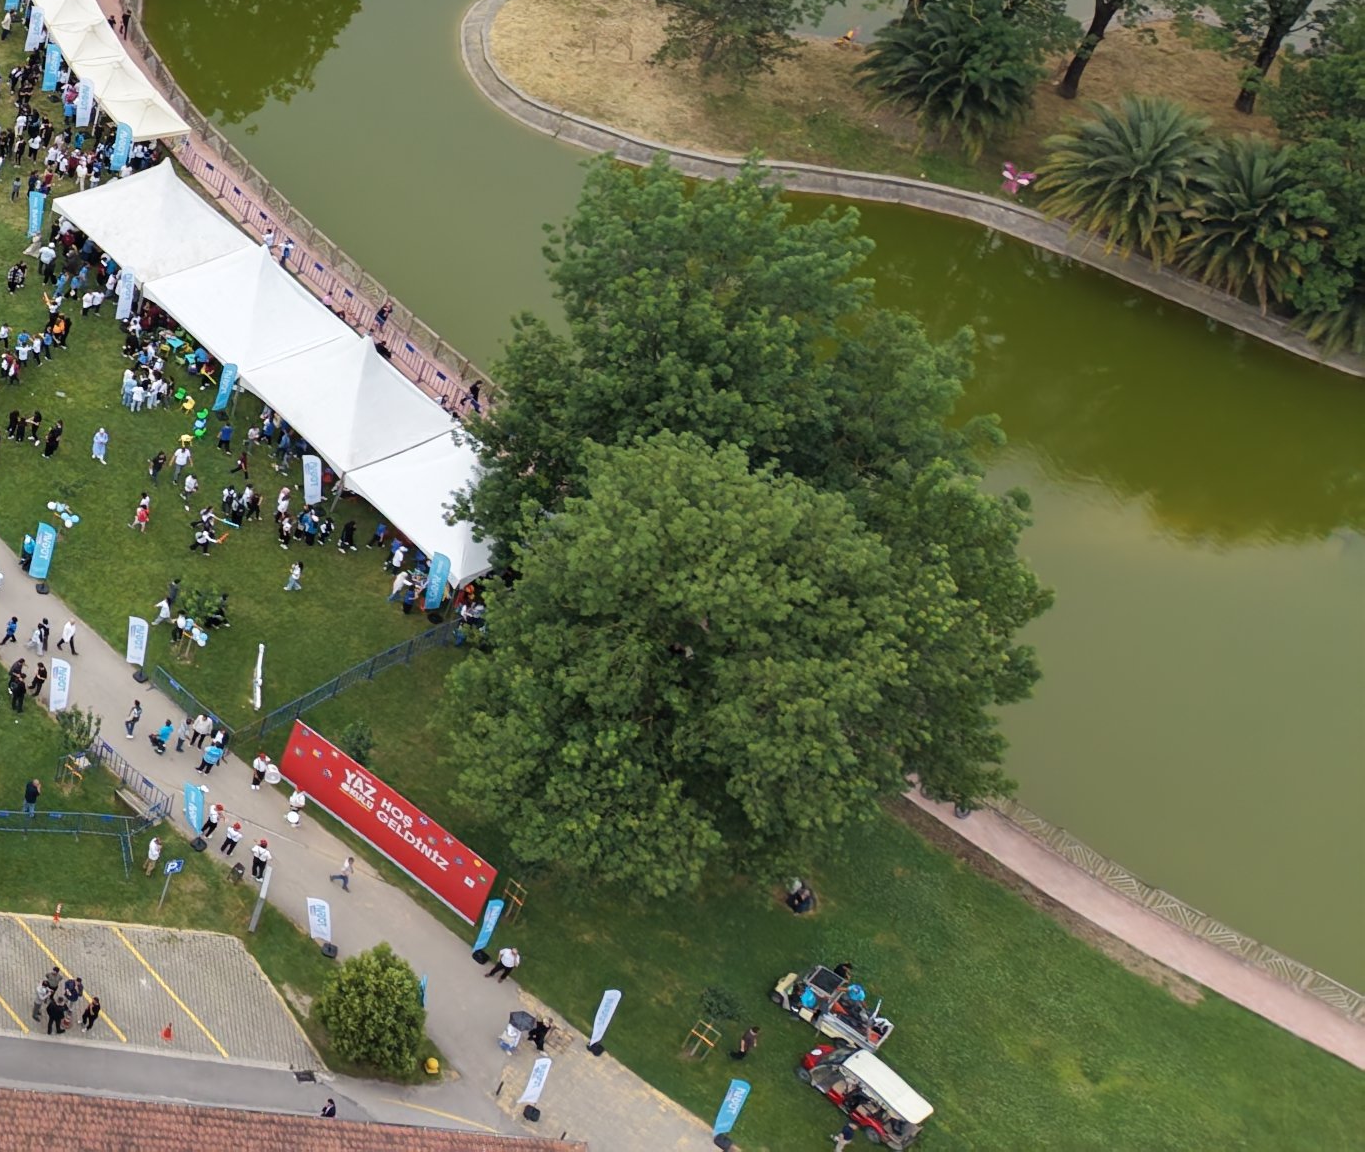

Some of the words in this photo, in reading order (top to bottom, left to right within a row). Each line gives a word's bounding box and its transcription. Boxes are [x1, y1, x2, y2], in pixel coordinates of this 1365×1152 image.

[345, 768, 377, 802] YAZ
[380, 798, 413, 829] HOŞ
[376, 810, 449, 871] GELDİNİZ
